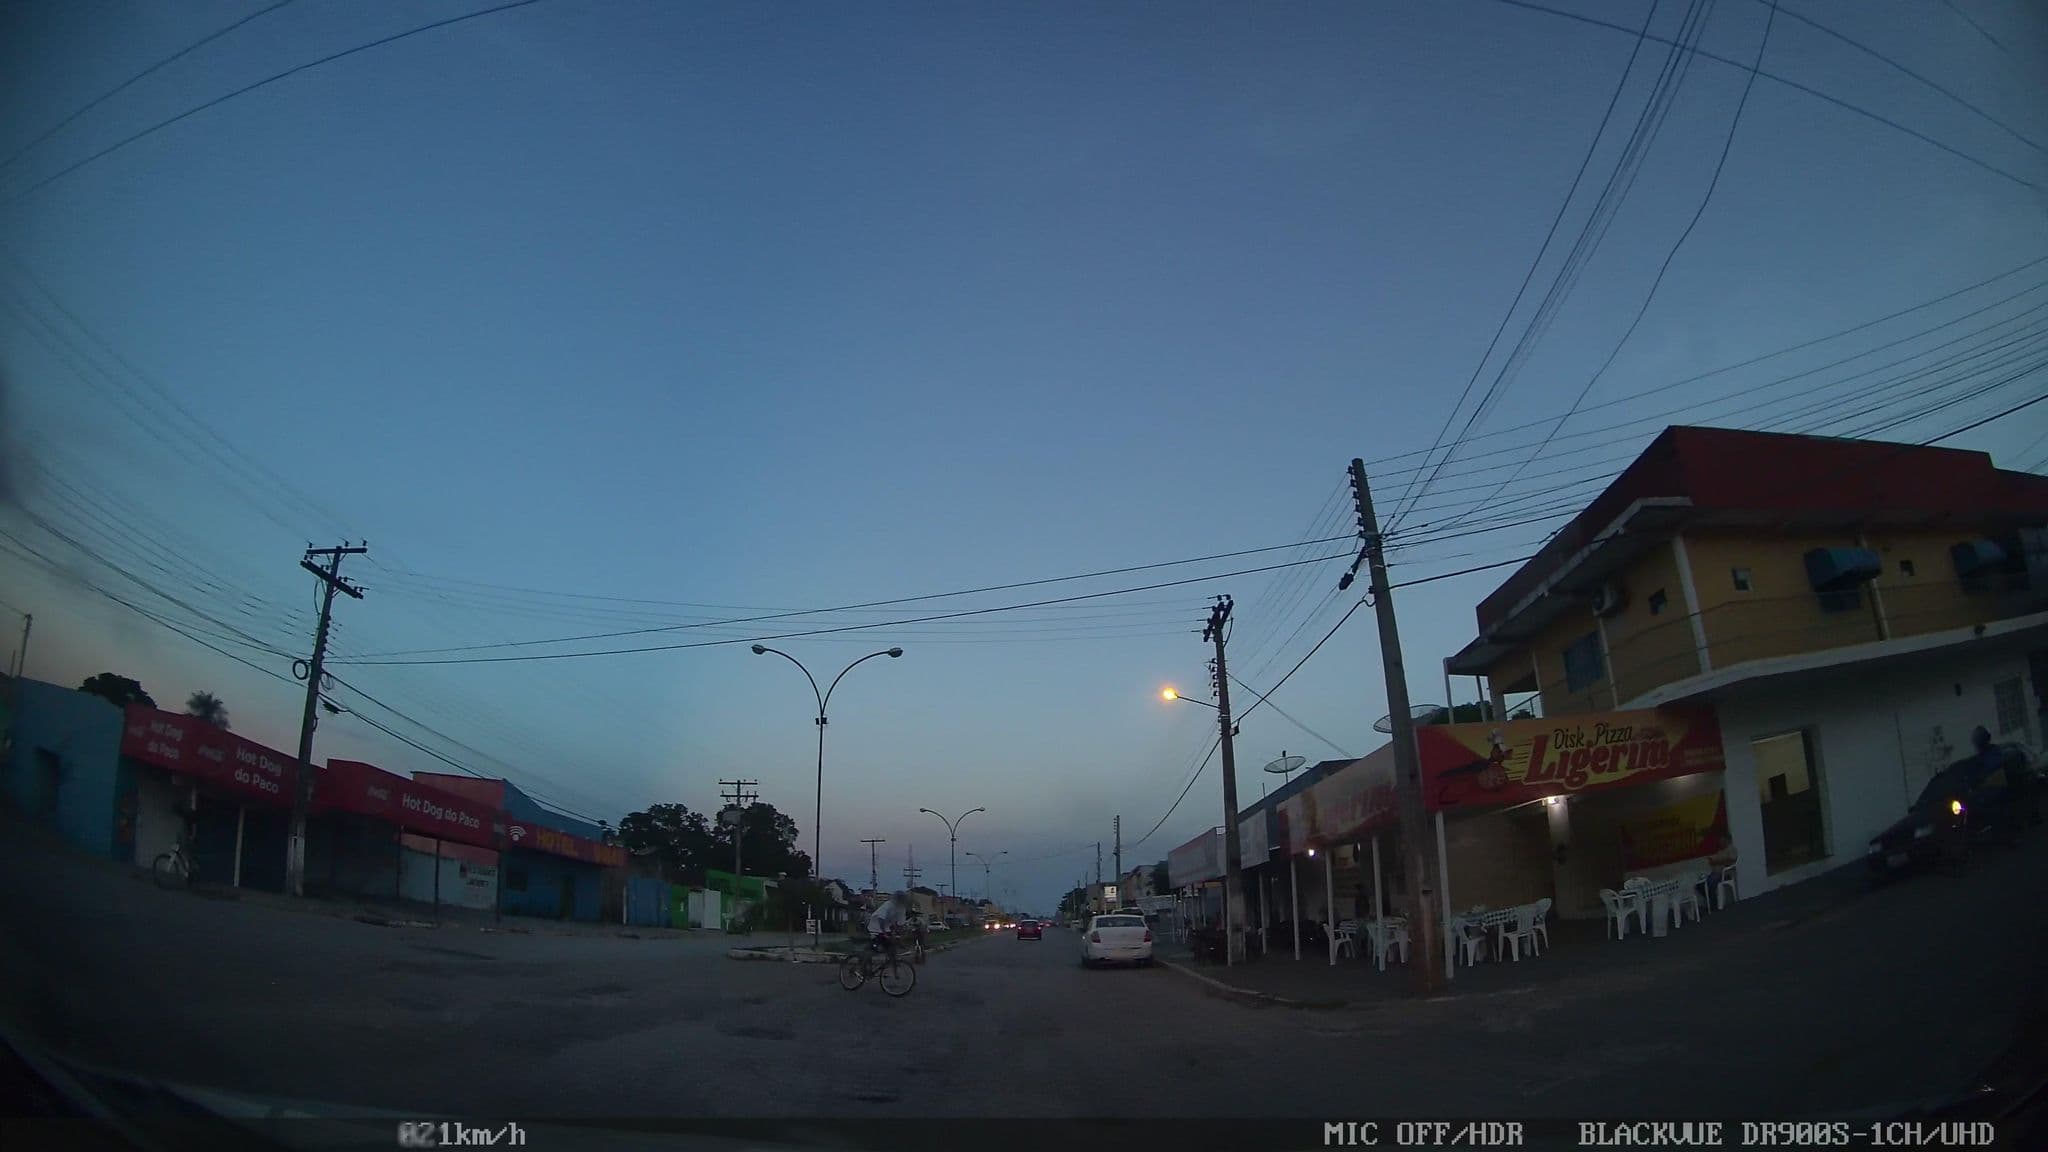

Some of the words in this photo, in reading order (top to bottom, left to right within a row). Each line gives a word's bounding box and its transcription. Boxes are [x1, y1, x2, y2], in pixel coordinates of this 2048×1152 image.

[1553, 728, 1584, 749] Disk
[1593, 723, 1633, 746] Pizza
[236, 745, 257, 765] Hot
[259, 755, 282, 777] Dog
[234, 768, 250, 783] do
[253, 773, 279, 794] Paco
[402, 793, 421, 811] Hot
[423, 799, 443, 820] Dog
[444, 808, 457, 822] do
[458, 811, 480, 829] Paco
